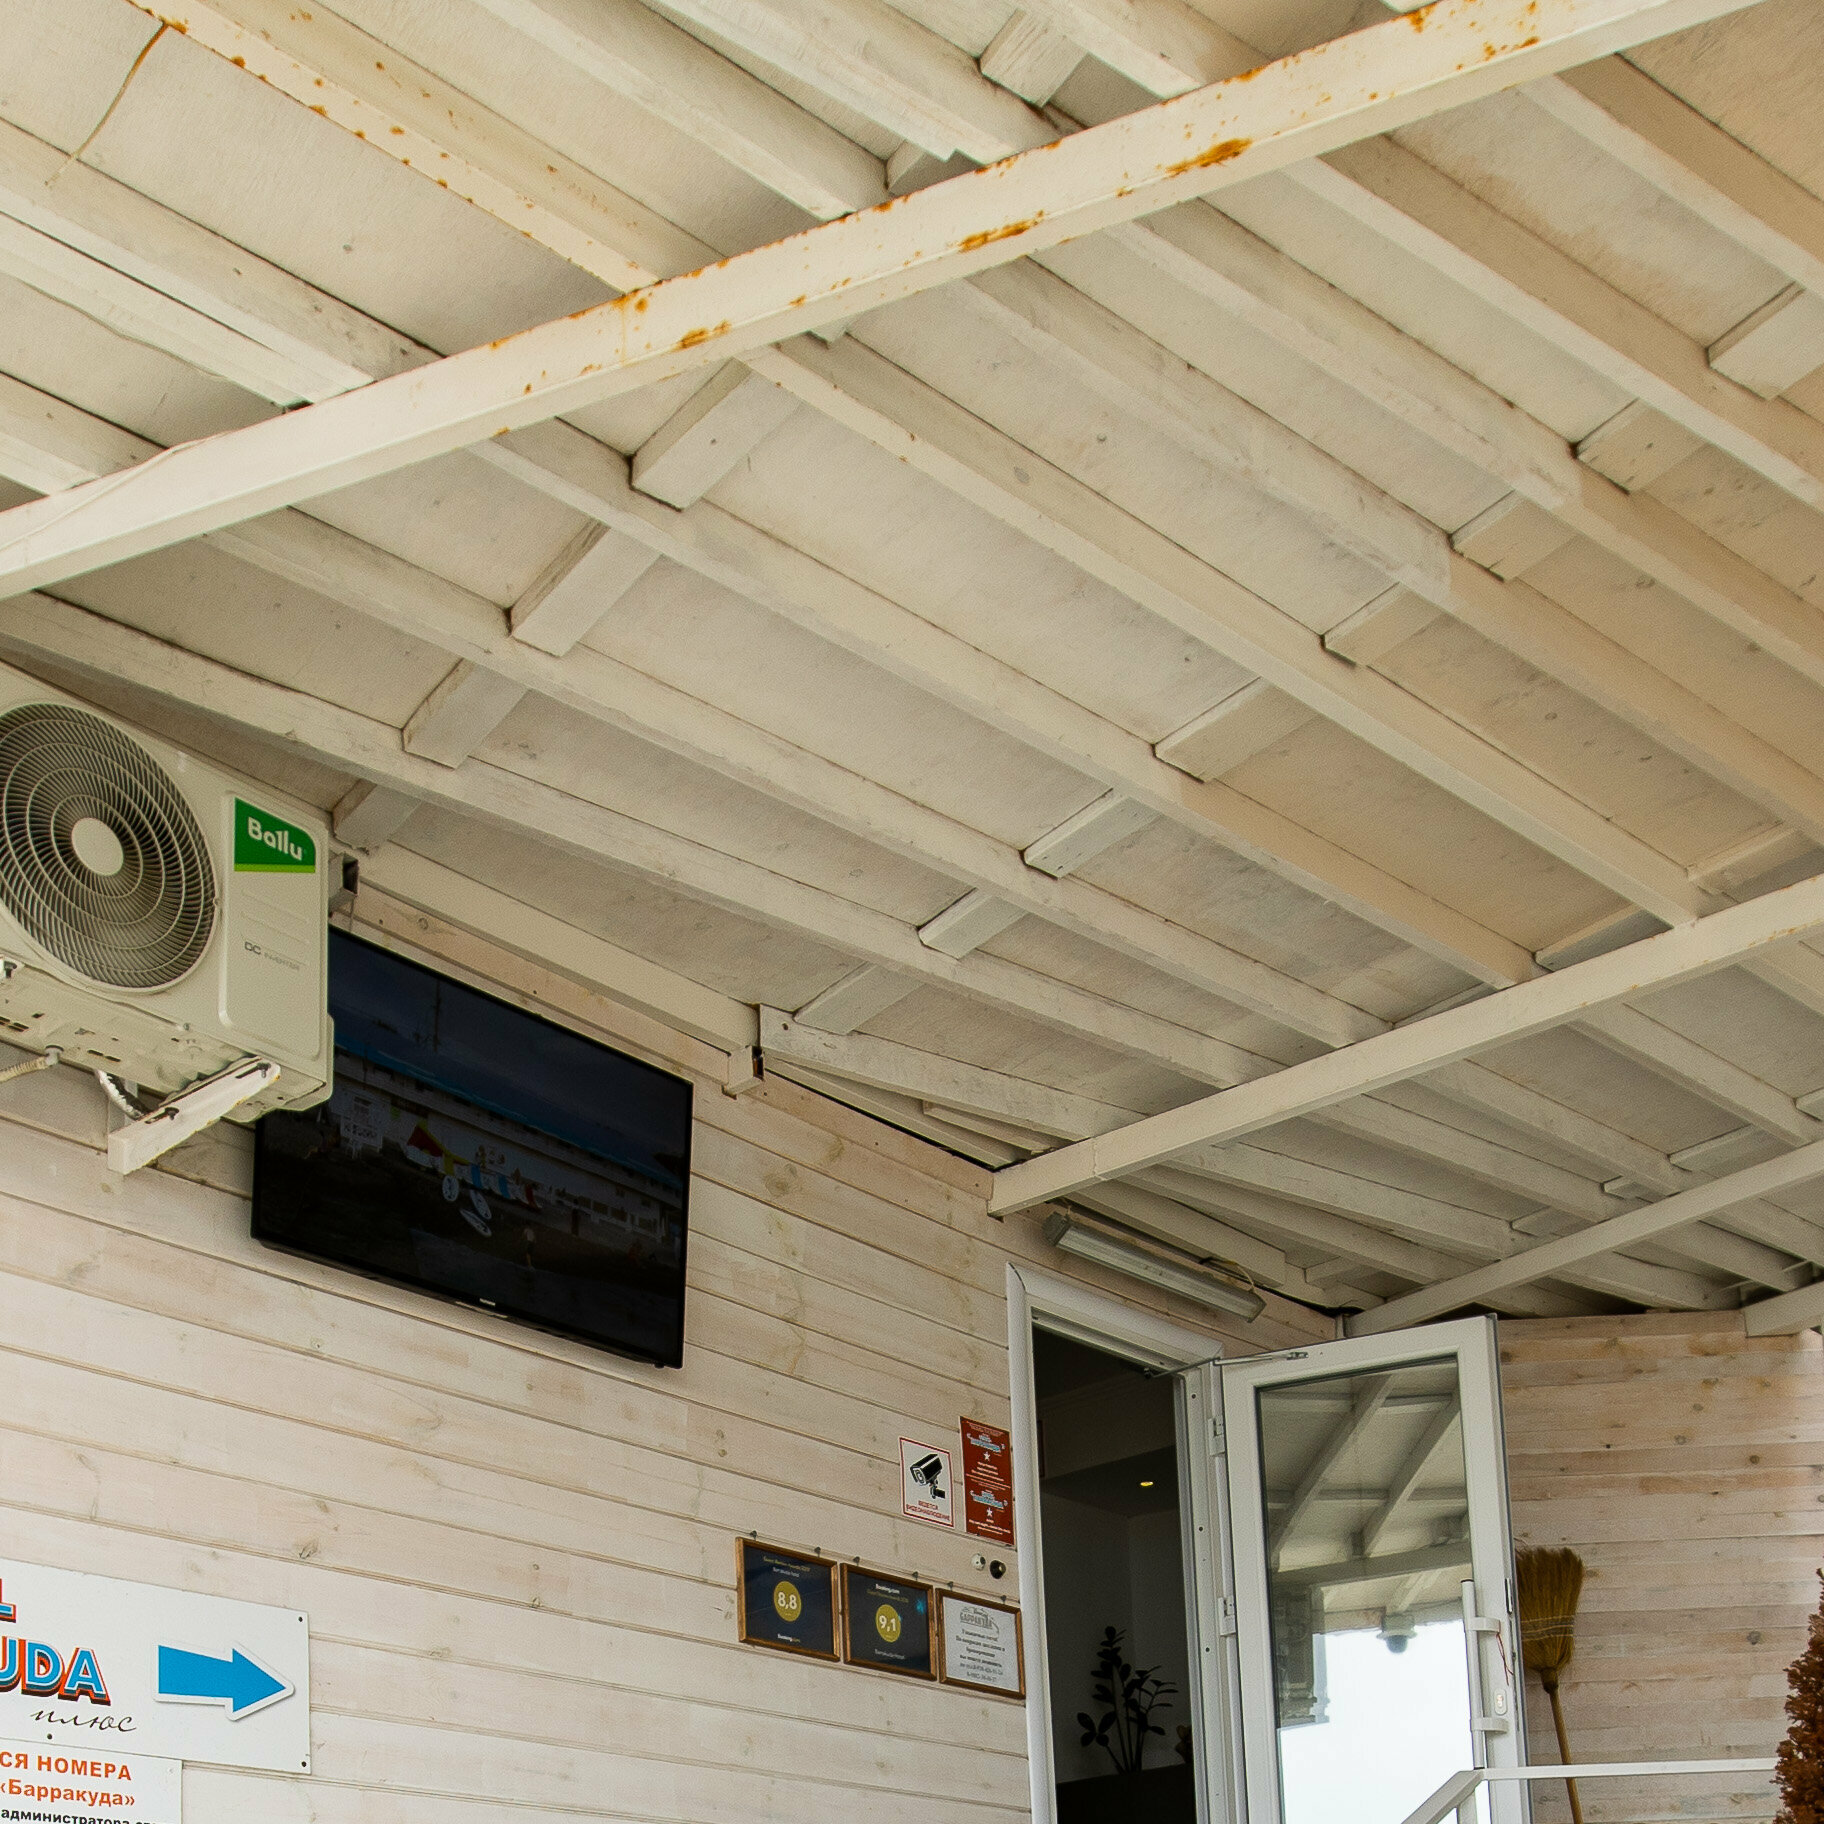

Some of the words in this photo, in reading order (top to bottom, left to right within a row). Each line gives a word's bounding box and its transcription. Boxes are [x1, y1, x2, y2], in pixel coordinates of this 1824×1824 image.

[247, 815, 303, 861] Ballu
[777, 1592, 798, 1610] 8,8
[878, 1614, 897, 1633] 9,1
[29, 1707, 140, 1735] плюс
[37, 1756, 133, 1782] НОМЕРА
